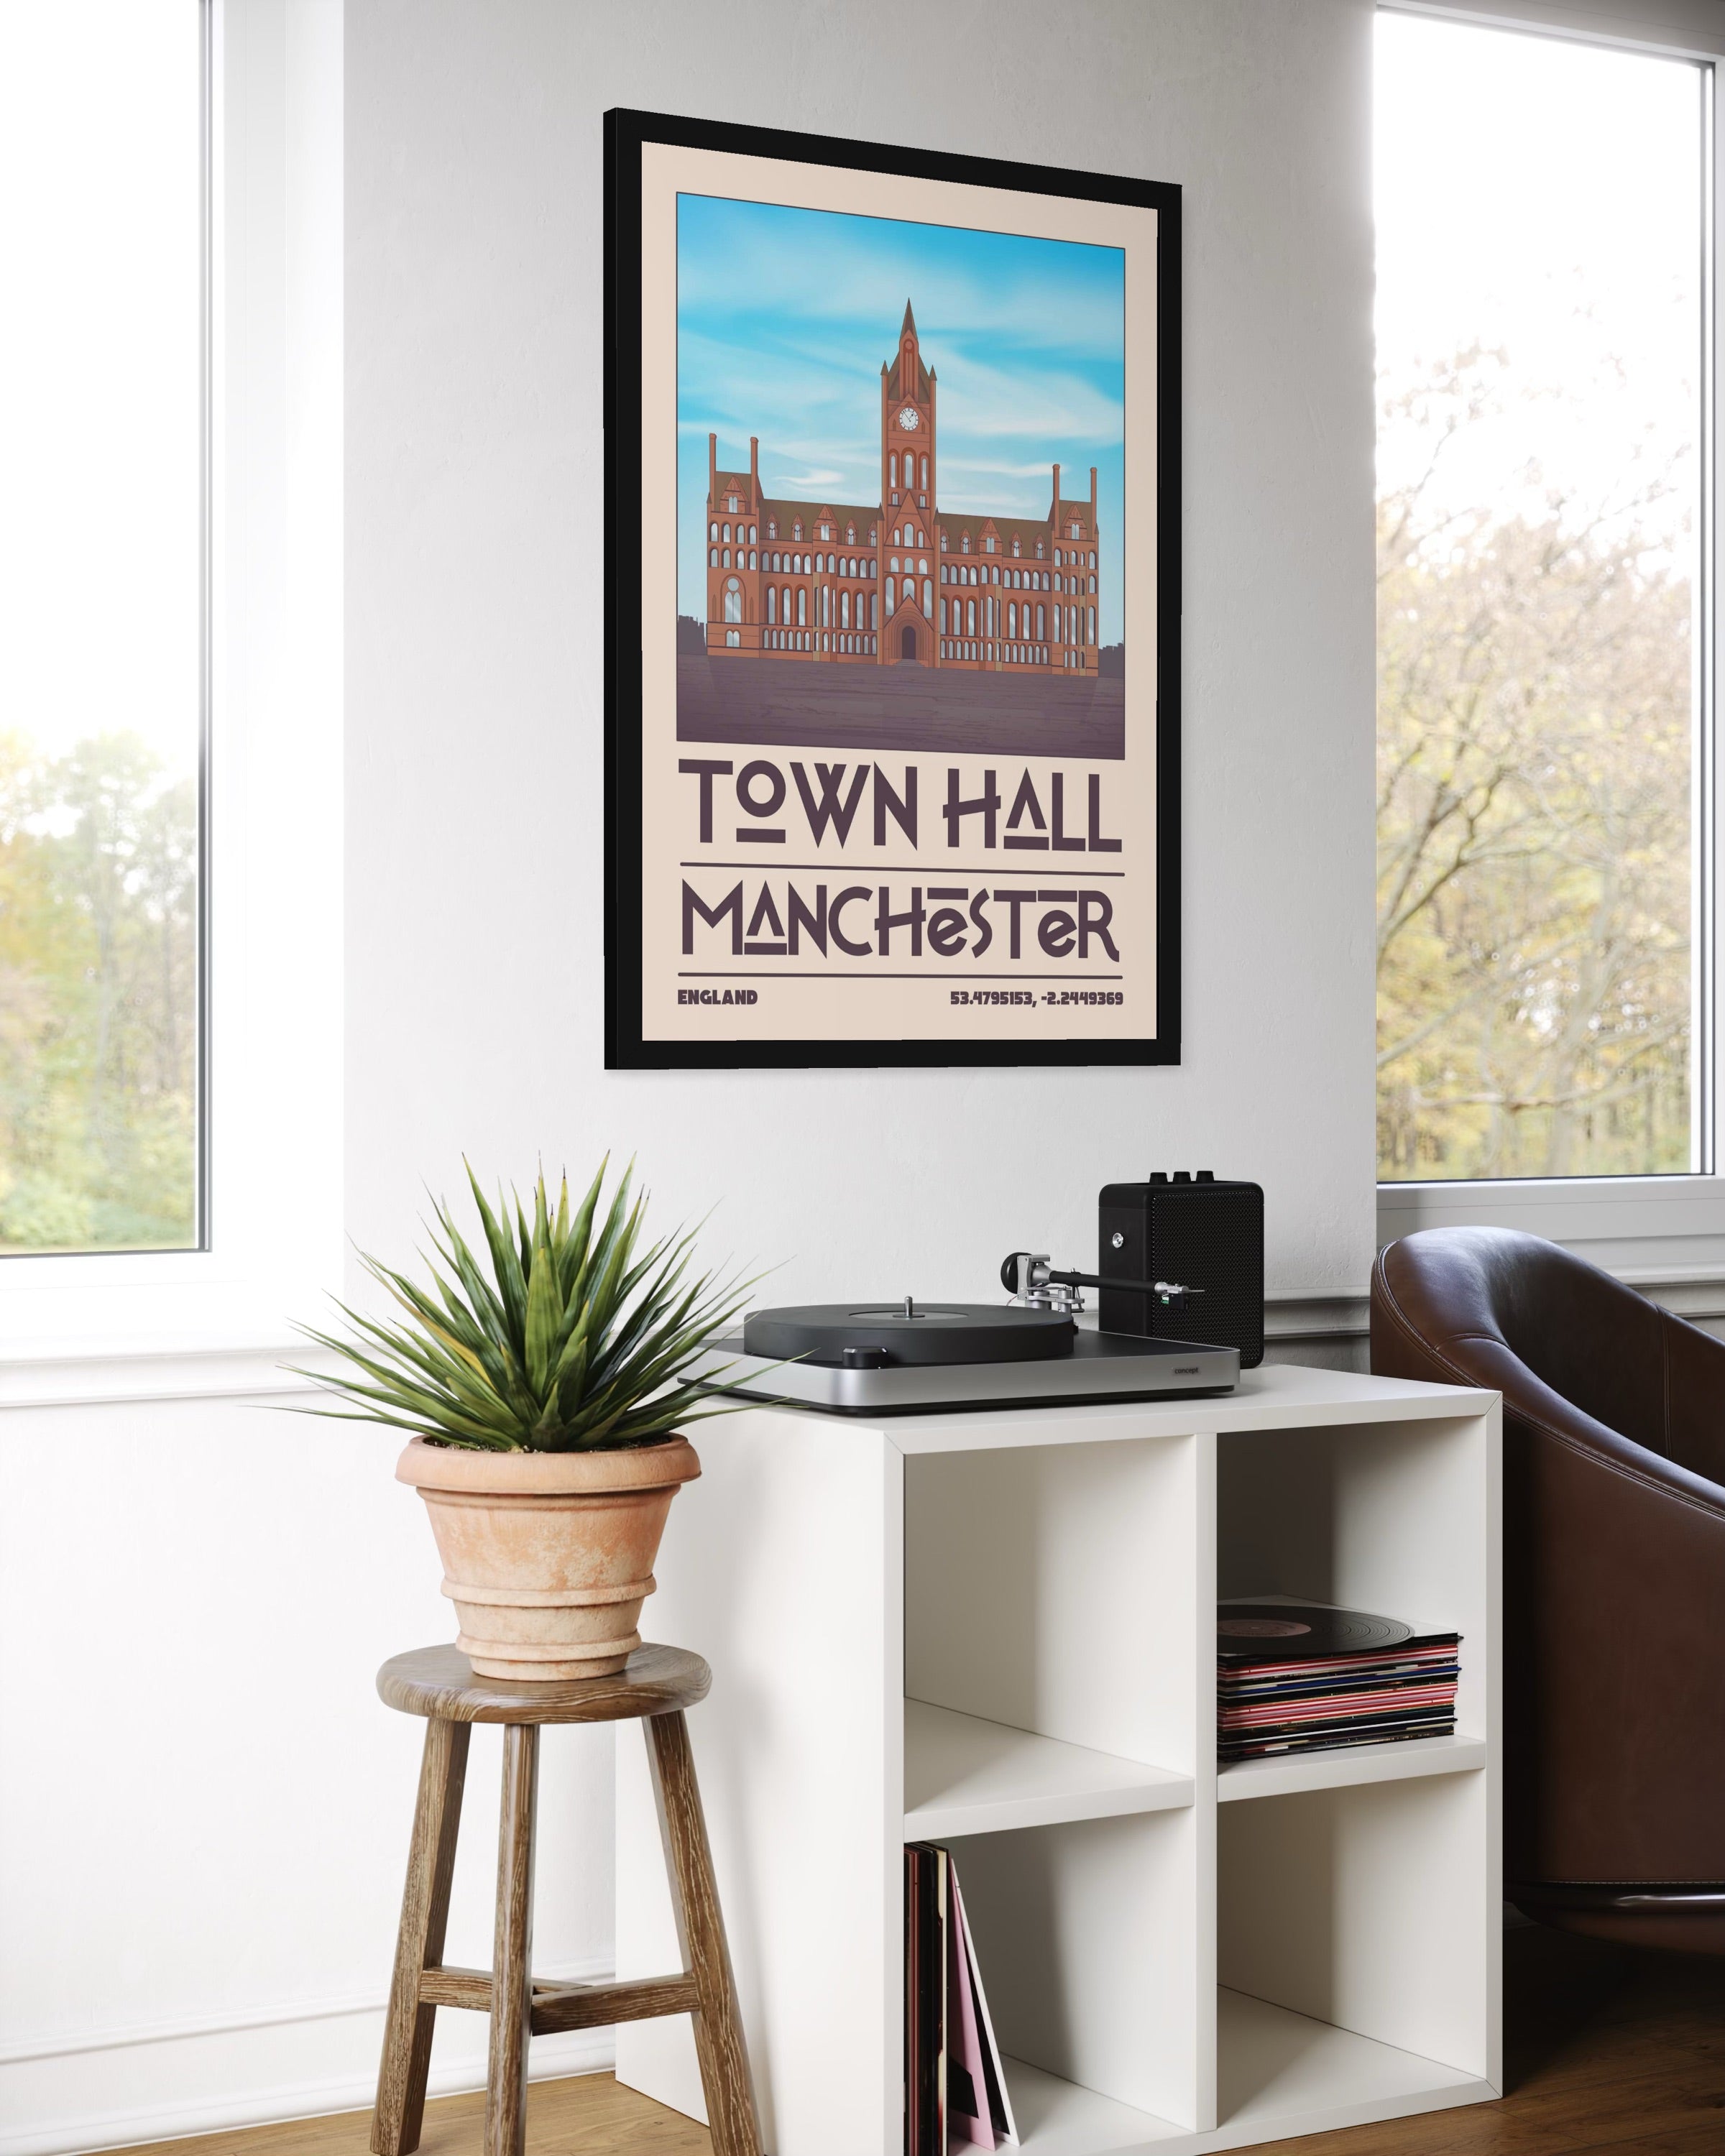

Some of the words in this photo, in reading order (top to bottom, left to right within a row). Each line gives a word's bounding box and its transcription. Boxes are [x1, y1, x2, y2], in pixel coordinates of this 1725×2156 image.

[678, 759, 918, 851] TOWN
[942, 767, 1123, 853] HALL
[677, 989, 758, 1005] ENGLAND
[950, 991, 1037, 1008] 53.4795153,
[1041, 991, 1123, 1005] -2.2449369
